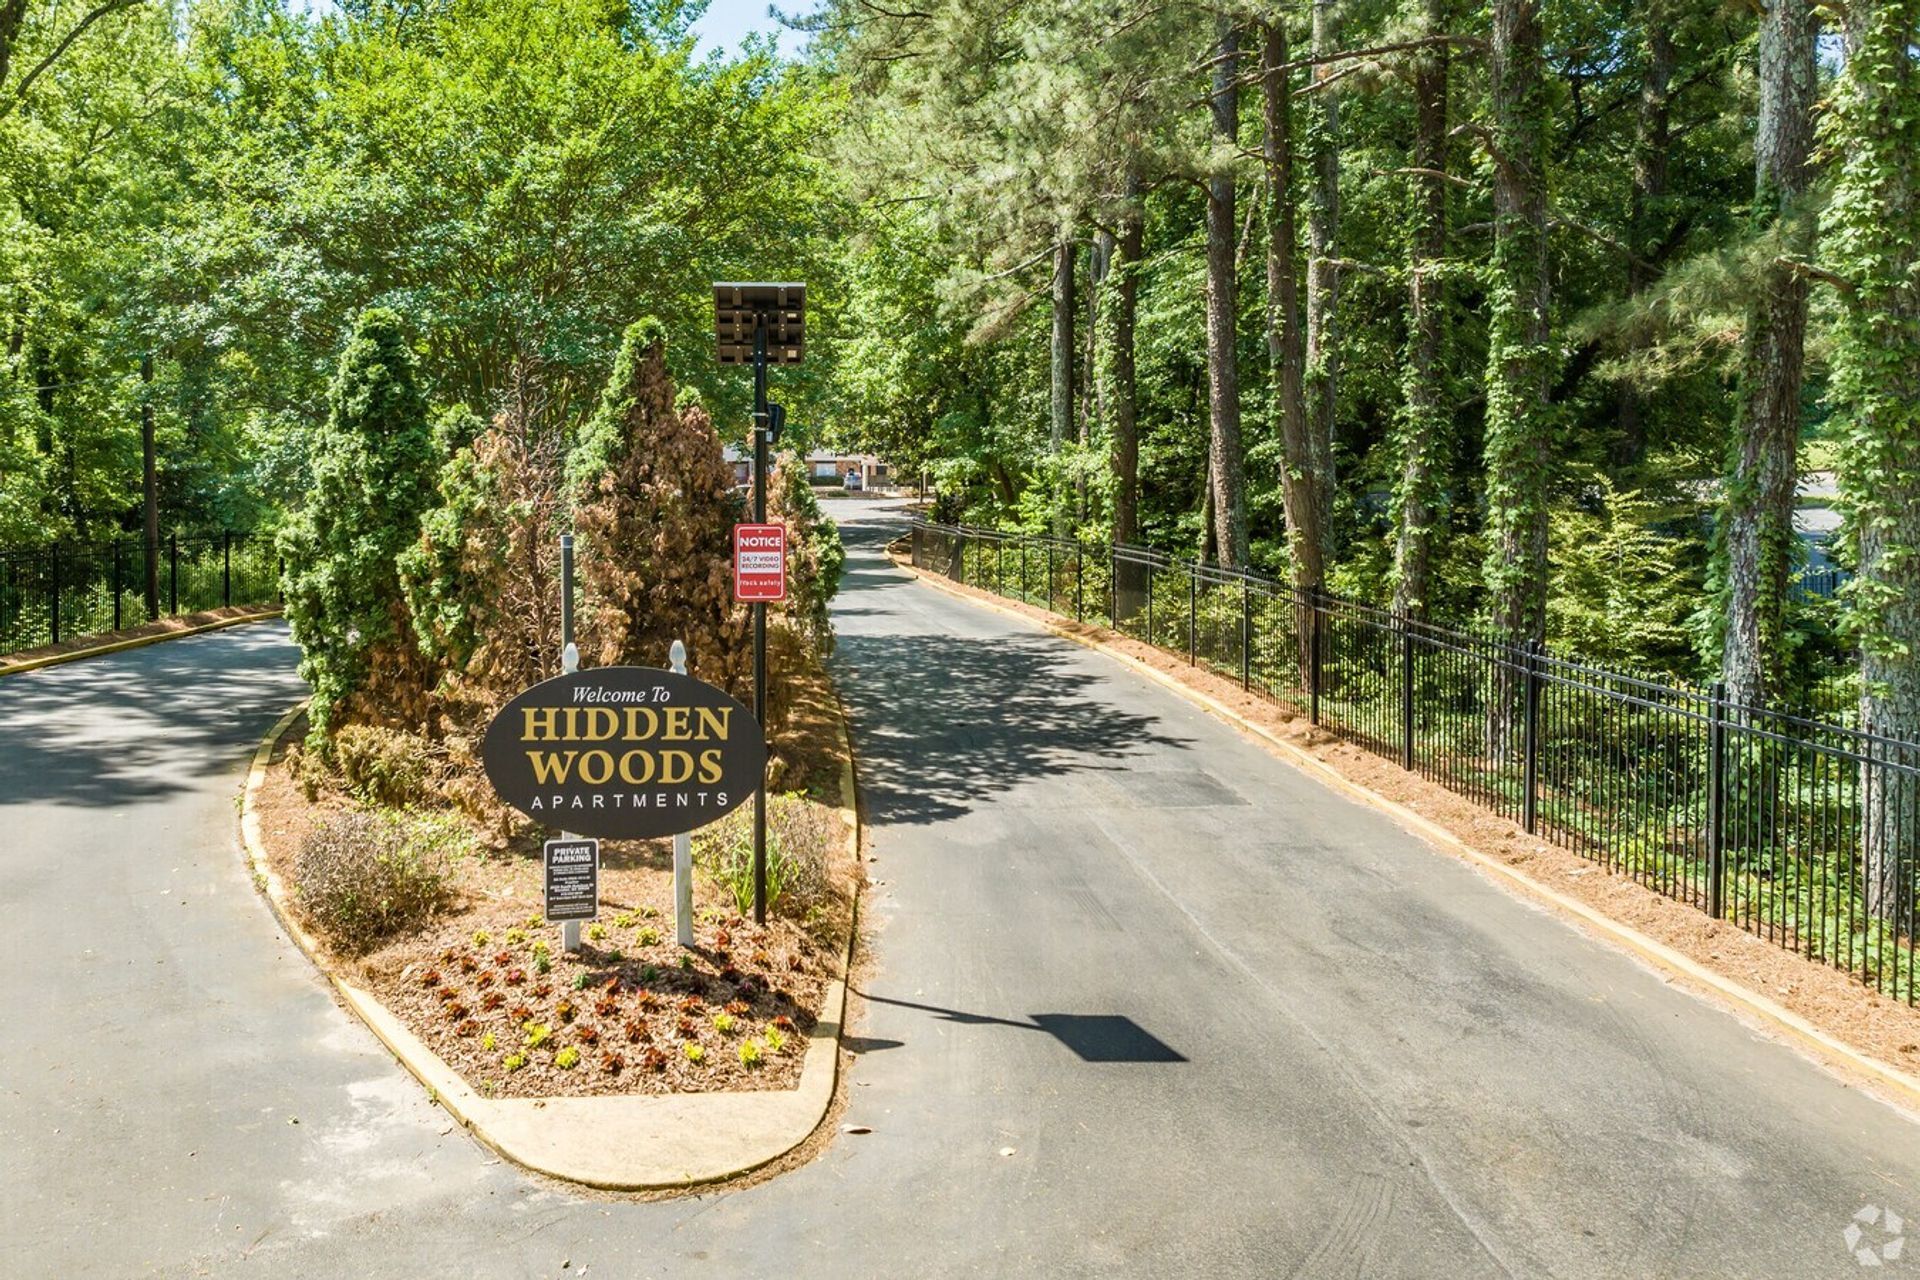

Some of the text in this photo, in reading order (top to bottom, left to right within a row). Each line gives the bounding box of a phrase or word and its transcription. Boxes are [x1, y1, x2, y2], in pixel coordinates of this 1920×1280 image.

[740, 537, 781, 547] NOTICE
[572, 686, 671, 703] Welcome To
[520, 706, 733, 741] HIDDEN
[526, 749, 723, 785] WOODS
[531, 791, 729, 810] APARTMENTS
[552, 855, 591, 863] PARKING
[554, 847, 590, 856] PRIVATE
